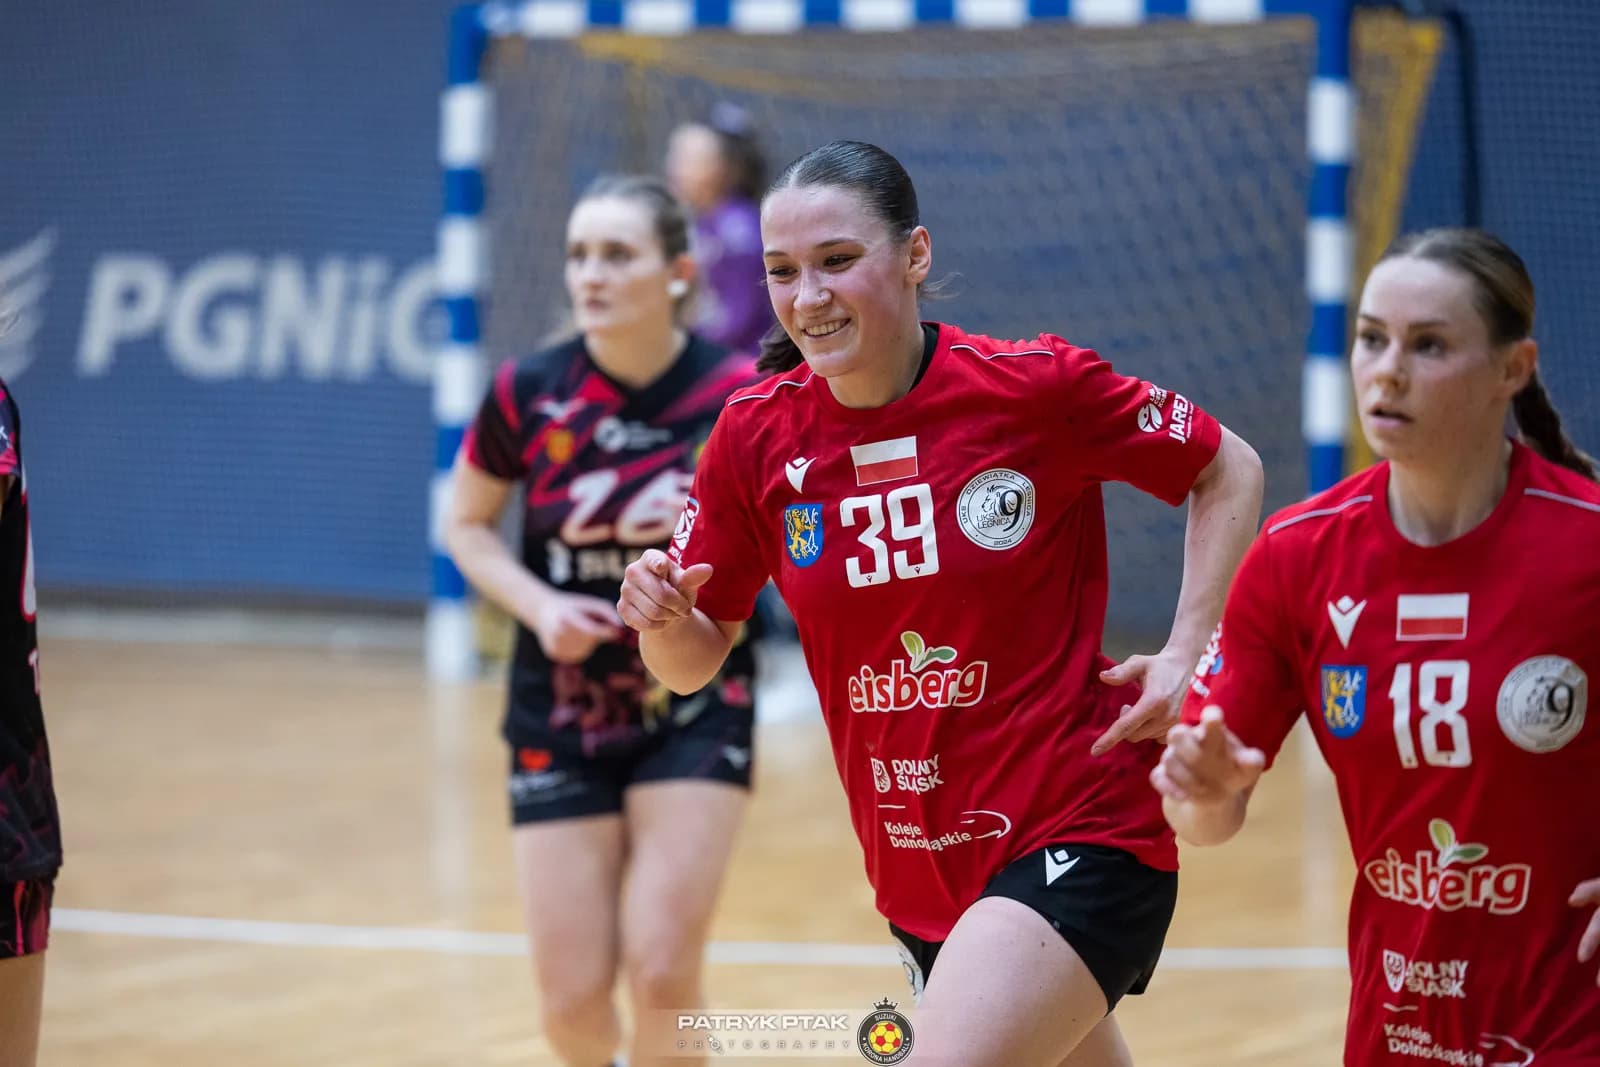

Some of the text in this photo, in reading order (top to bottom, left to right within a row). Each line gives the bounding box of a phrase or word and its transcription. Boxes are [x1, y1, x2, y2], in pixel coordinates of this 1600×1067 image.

[560, 469, 695, 546] 26
[839, 483, 940, 588] 39
[848, 659, 989, 713] eisberg
[1388, 660, 1472, 769] 18
[891, 754, 939, 776] DOLNY
[884, 821, 922, 838] Koleje
[889, 832, 972, 851] Dolnoląskie
[1364, 847, 1532, 915] eisberg
